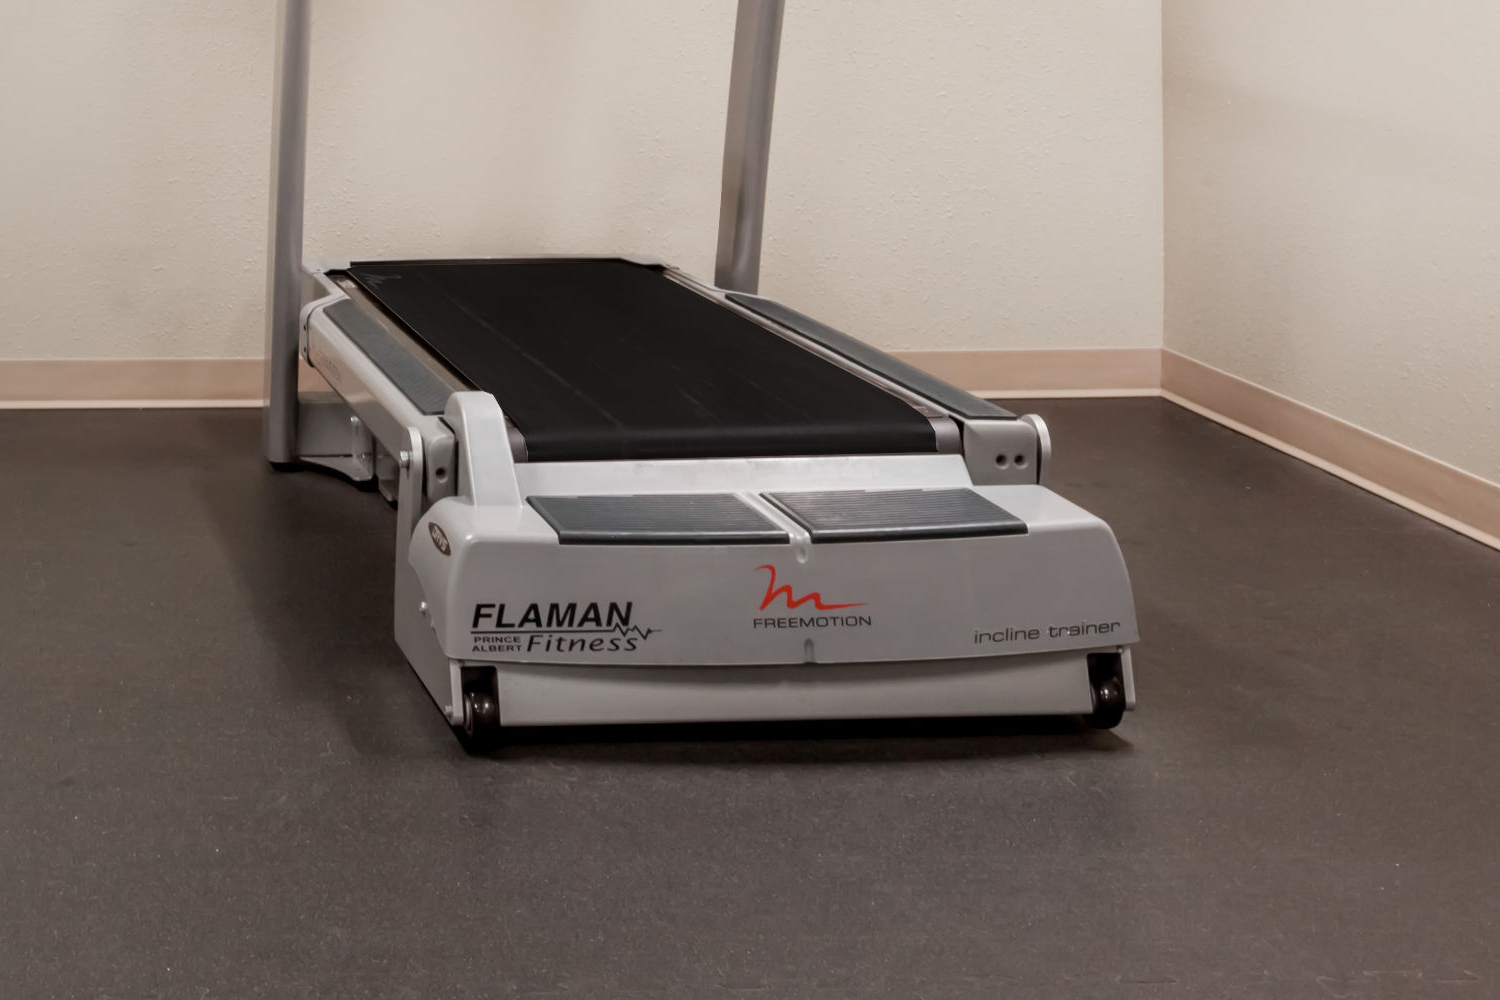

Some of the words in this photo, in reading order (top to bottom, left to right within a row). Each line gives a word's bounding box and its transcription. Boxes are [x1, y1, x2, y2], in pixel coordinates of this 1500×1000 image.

[472, 601, 633, 629] FLAMAN
[753, 615, 872, 629] FREEMOTION
[473, 635, 522, 644] PRINCE
[973, 626, 1041, 644] incline
[1049, 621, 1121, 638] trainer
[471, 644, 523, 653] ALBERT
[526, 634, 638, 653] Fitness
